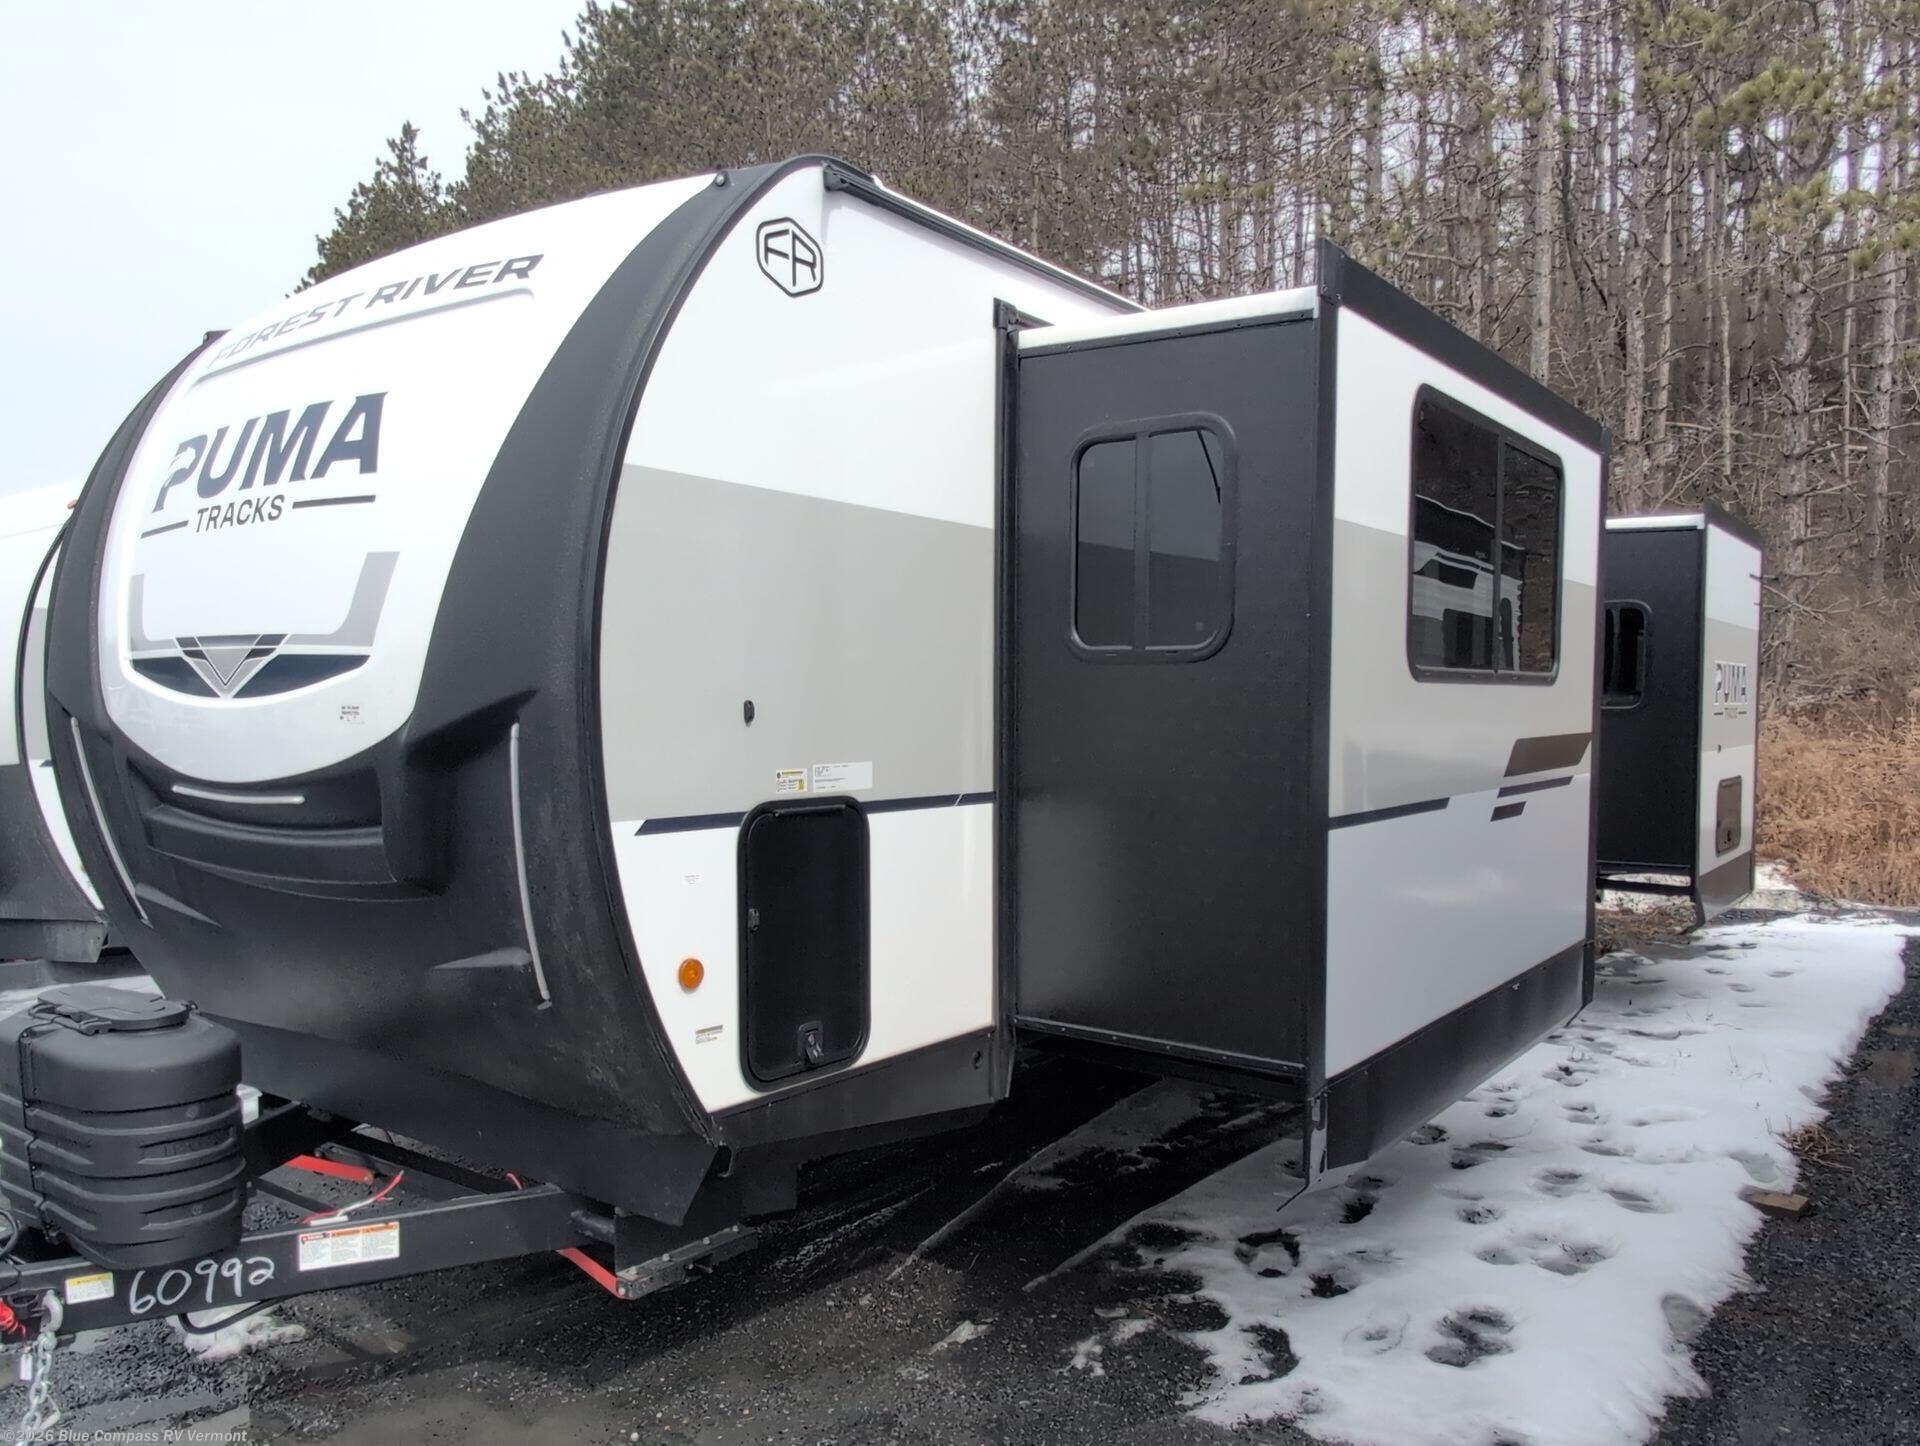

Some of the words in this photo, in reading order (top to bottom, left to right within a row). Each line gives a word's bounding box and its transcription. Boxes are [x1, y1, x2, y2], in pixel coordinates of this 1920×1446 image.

[206, 293, 365, 369] FOREST
[365, 253, 544, 309] RIVER
[152, 391, 388, 513] PUMA
[196, 494, 285, 533] TRACKS
[1714, 661, 1748, 704] PUMA
[129, 1256, 275, 1315] 60992
